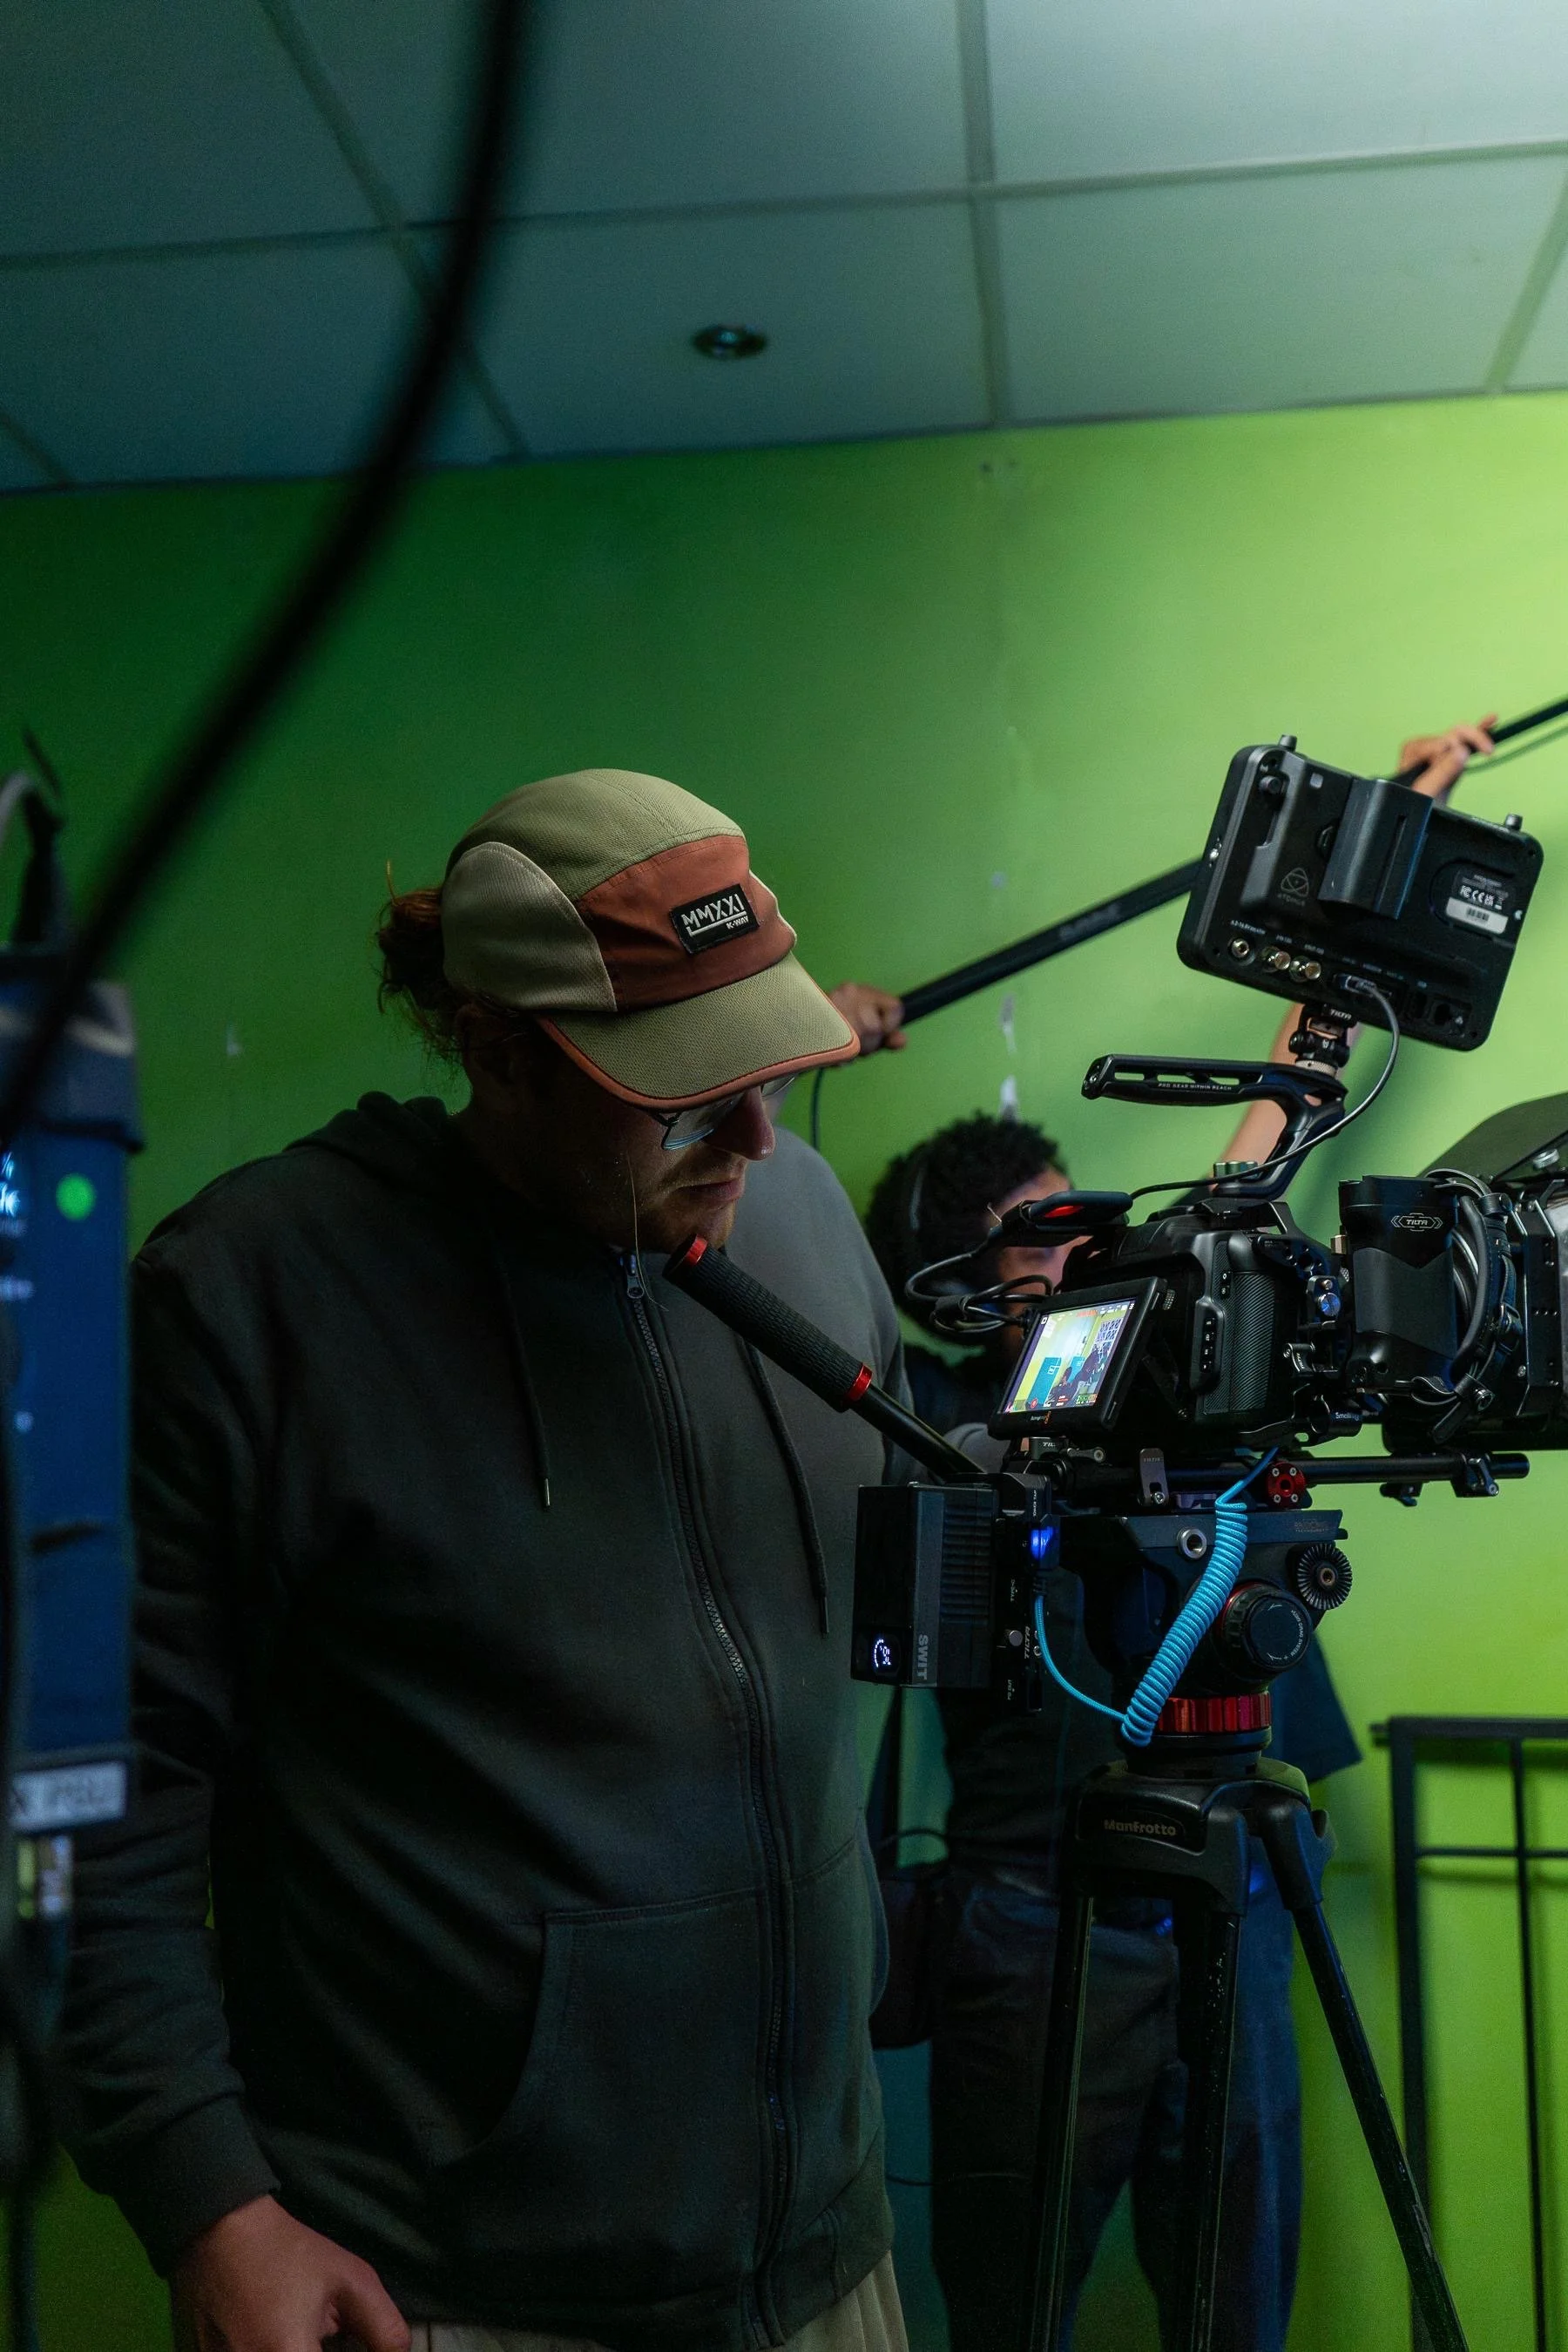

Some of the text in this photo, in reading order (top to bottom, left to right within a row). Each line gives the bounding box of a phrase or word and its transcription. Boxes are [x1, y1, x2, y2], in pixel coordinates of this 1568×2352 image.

[681, 894, 745, 928] MMXXI
[917, 1633, 929, 1680] SWIT
[1104, 1819, 1177, 1836] Manfrotto
